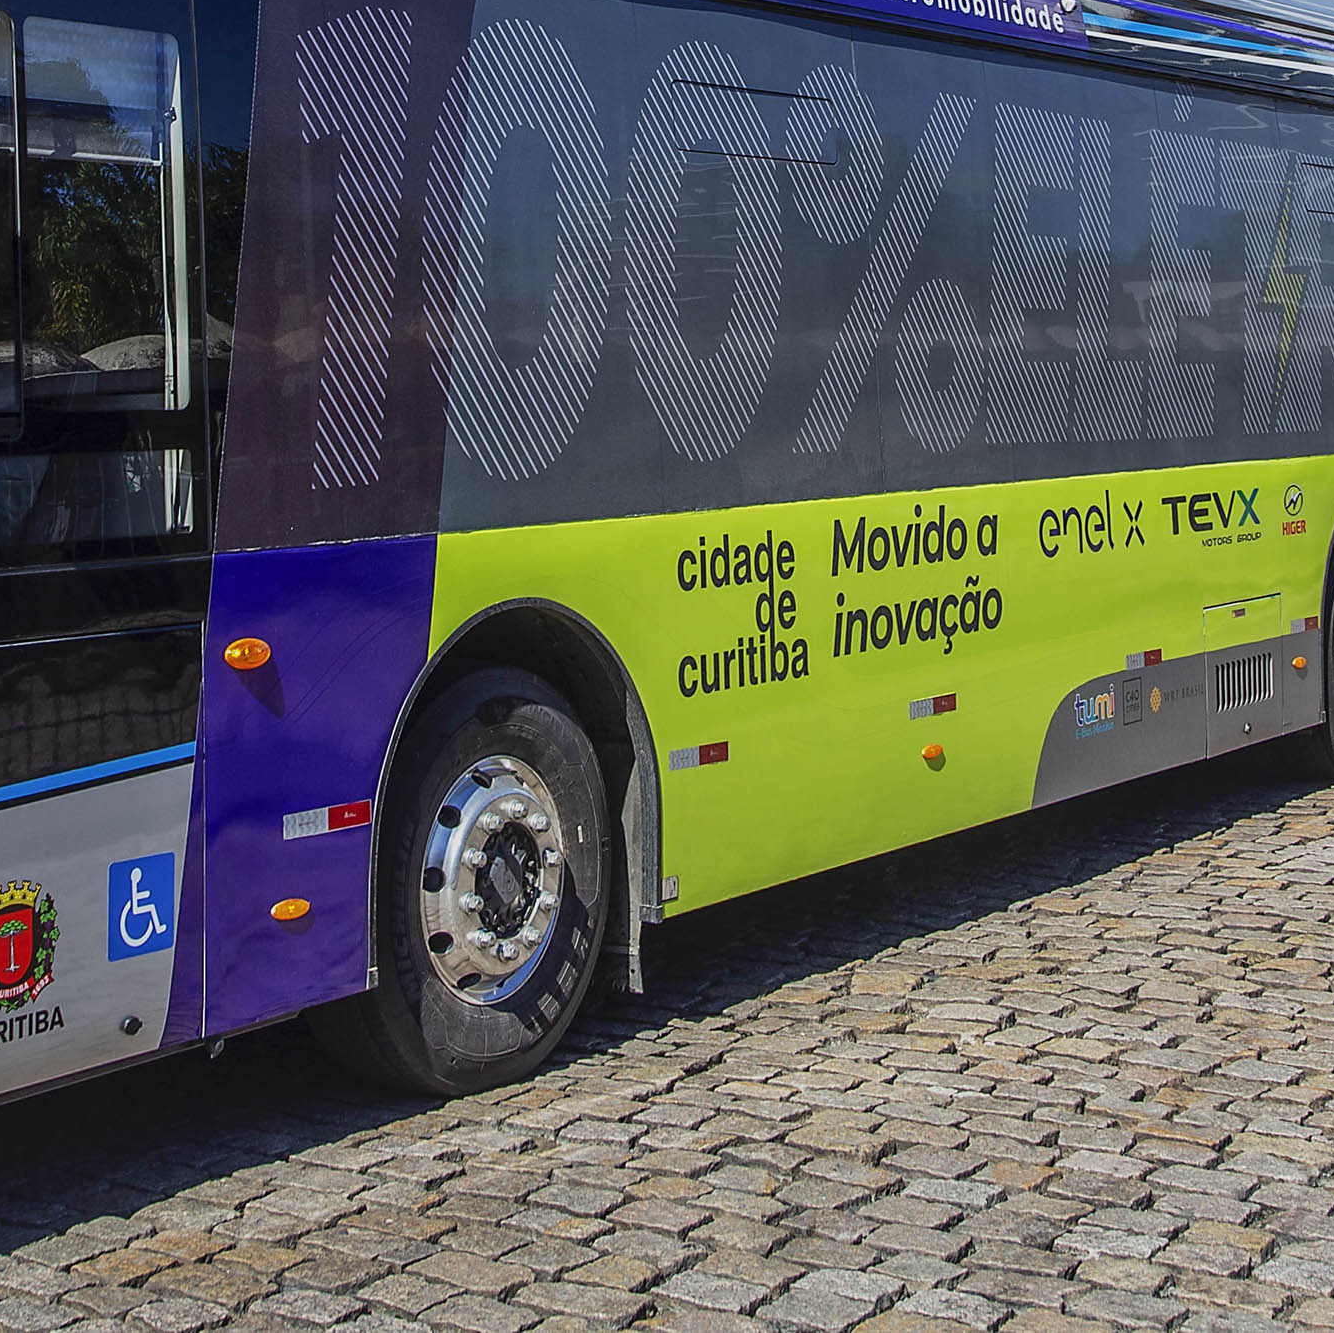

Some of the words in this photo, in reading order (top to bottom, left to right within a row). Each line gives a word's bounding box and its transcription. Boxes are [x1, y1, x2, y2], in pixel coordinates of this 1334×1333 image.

[1039, 489, 1115, 558] enel
[1161, 488, 1260, 535] TEVX
[1236, 531, 1262, 543] GROUP
[1282, 519, 1307, 536] HIGER
[677, 529, 795, 592] cidade
[831, 503, 967, 577] Movido
[977, 514, 998, 556] a
[756, 586, 797, 632] de
[833, 574, 1003, 658] inovação
[678, 633, 810, 698] curitiba
[1074, 683, 1115, 727] tumi
